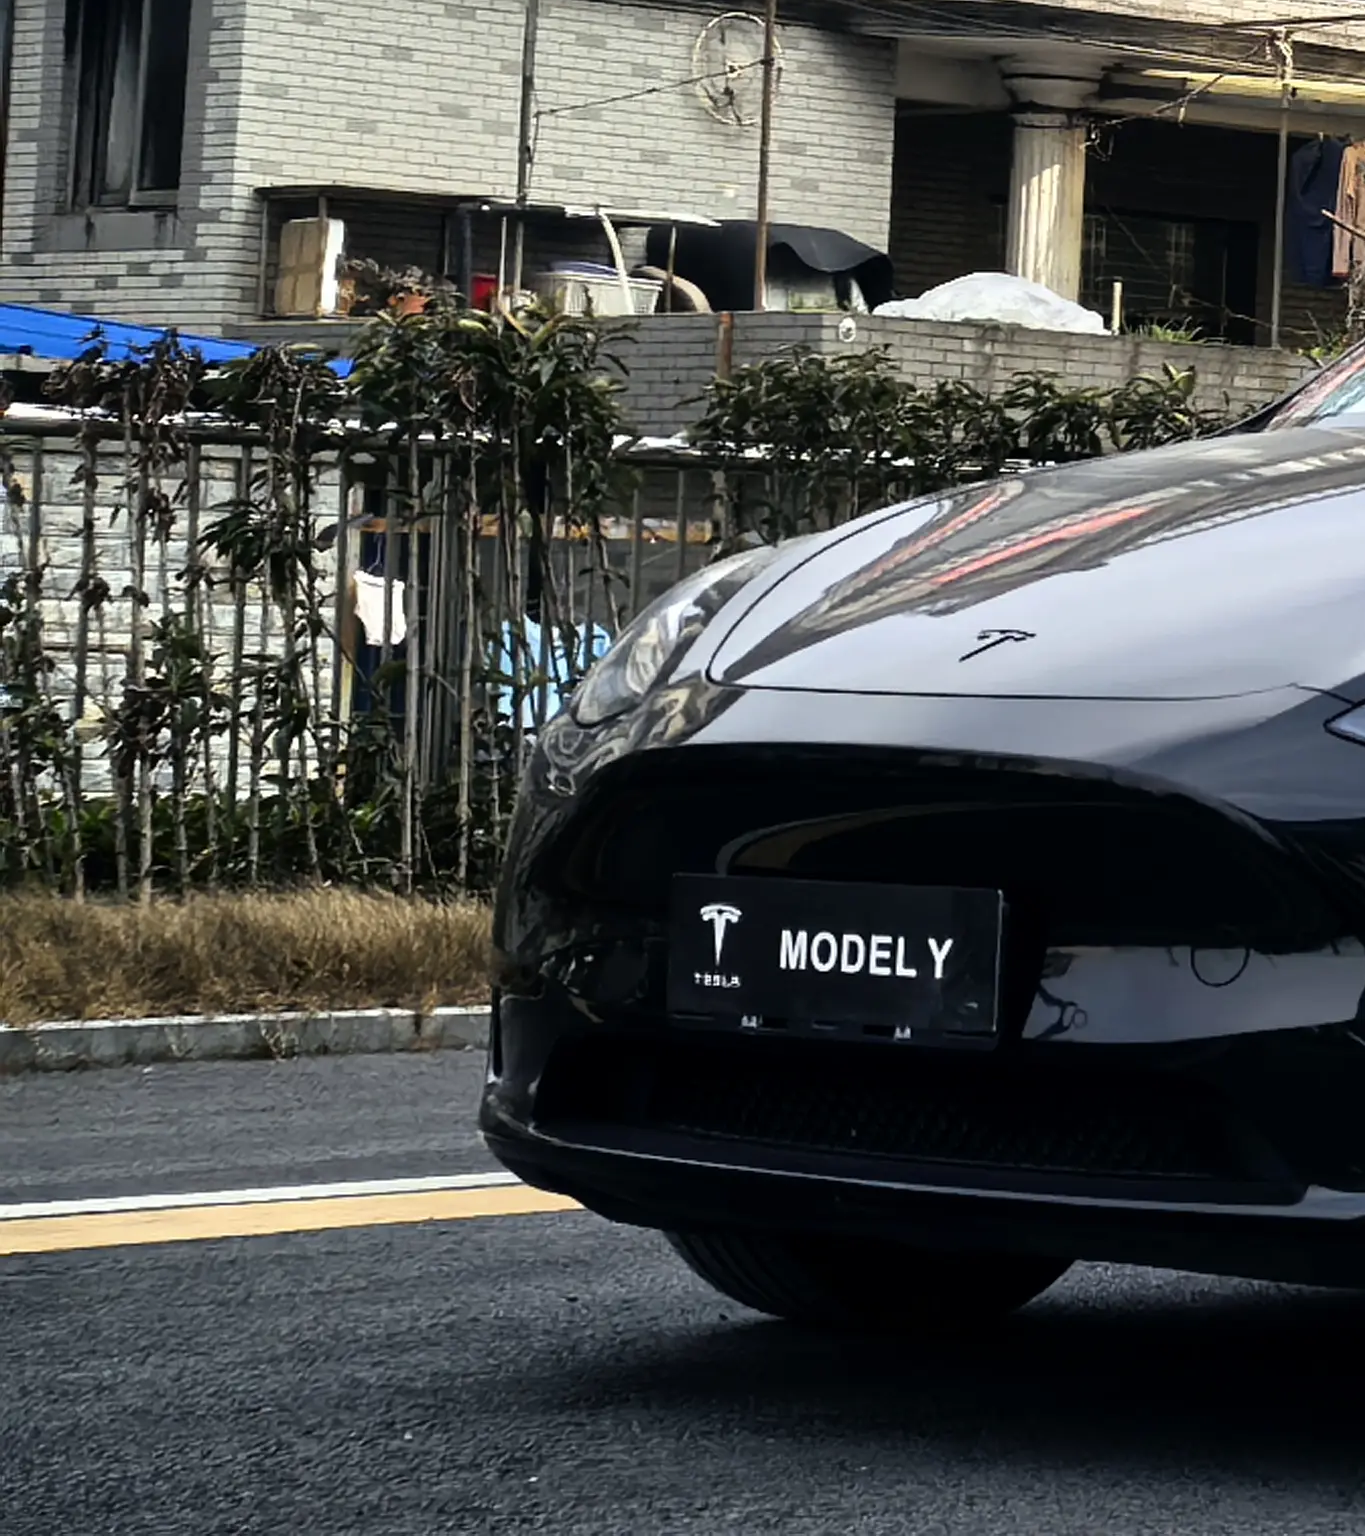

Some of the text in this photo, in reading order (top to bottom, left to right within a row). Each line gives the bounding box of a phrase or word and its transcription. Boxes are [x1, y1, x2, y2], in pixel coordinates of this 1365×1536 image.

[778, 929, 955, 980] MODEL Y
[693, 971, 742, 989] TESLA
